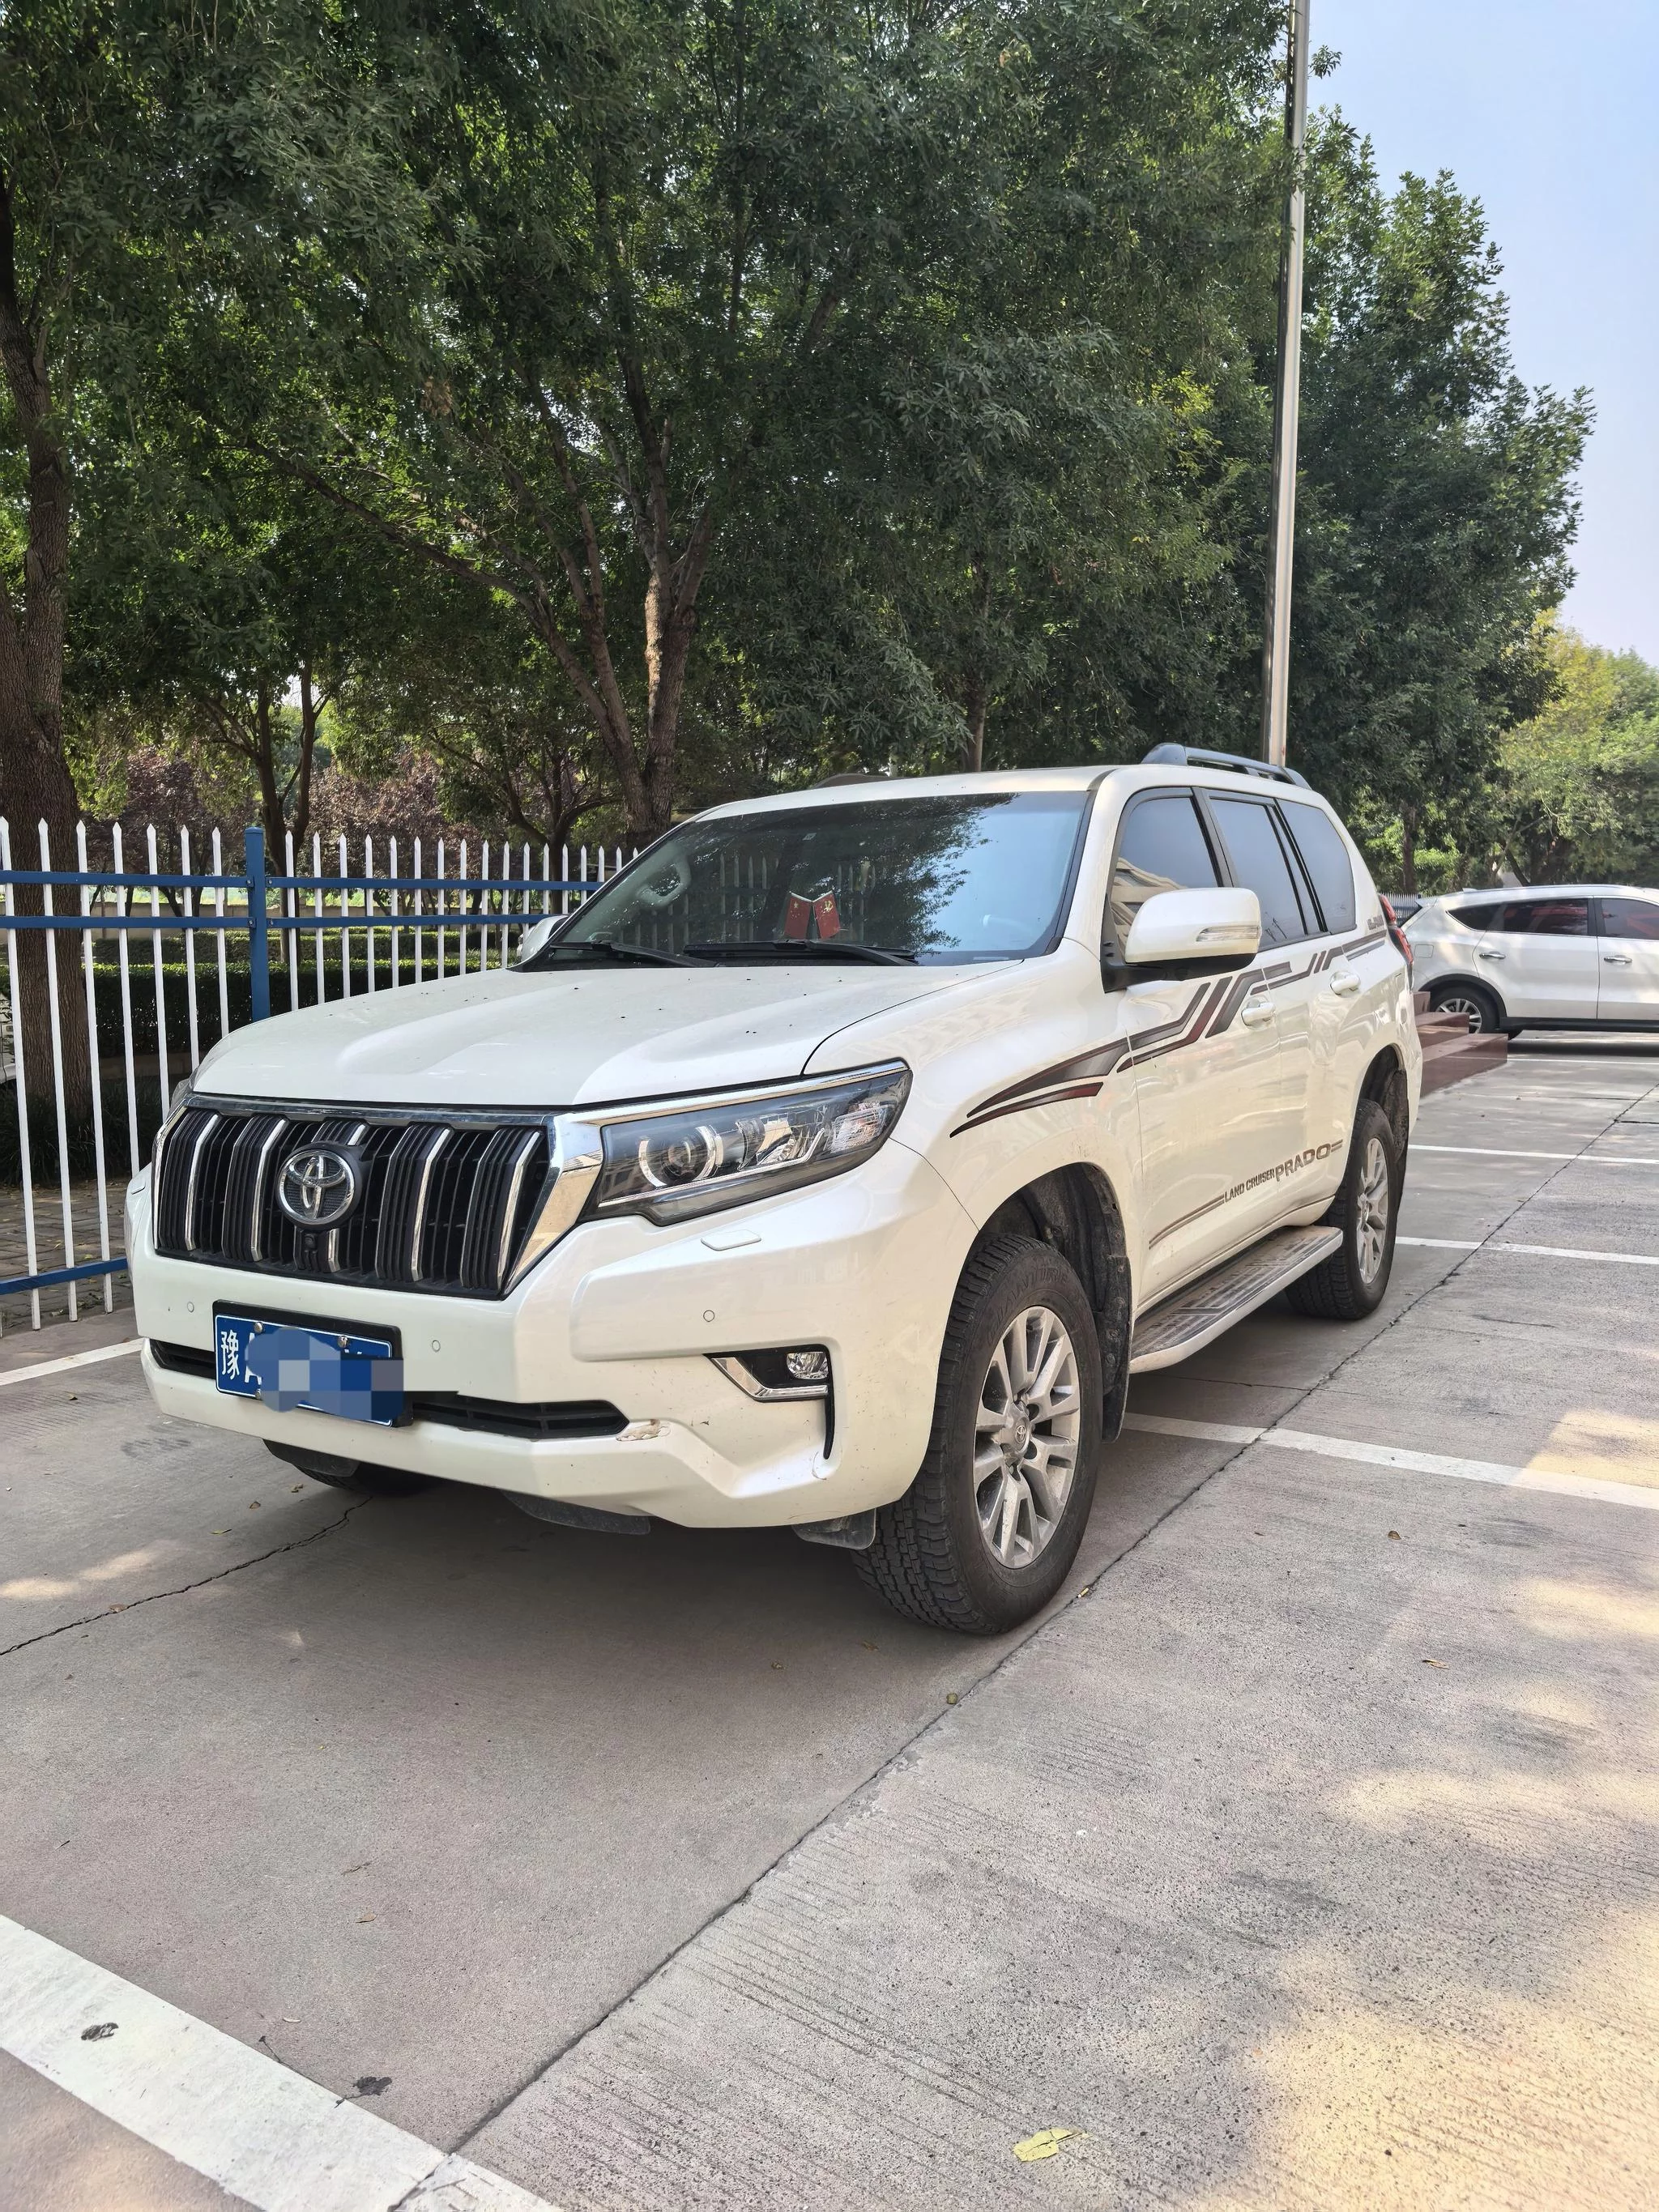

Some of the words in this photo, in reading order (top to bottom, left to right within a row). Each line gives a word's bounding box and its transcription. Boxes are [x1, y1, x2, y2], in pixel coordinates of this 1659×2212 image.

[1225, 1183, 1244, 1202] LAND
[1246, 1169, 1274, 1191] CRUISER
[1275, 1143, 1331, 1182] PRADO
